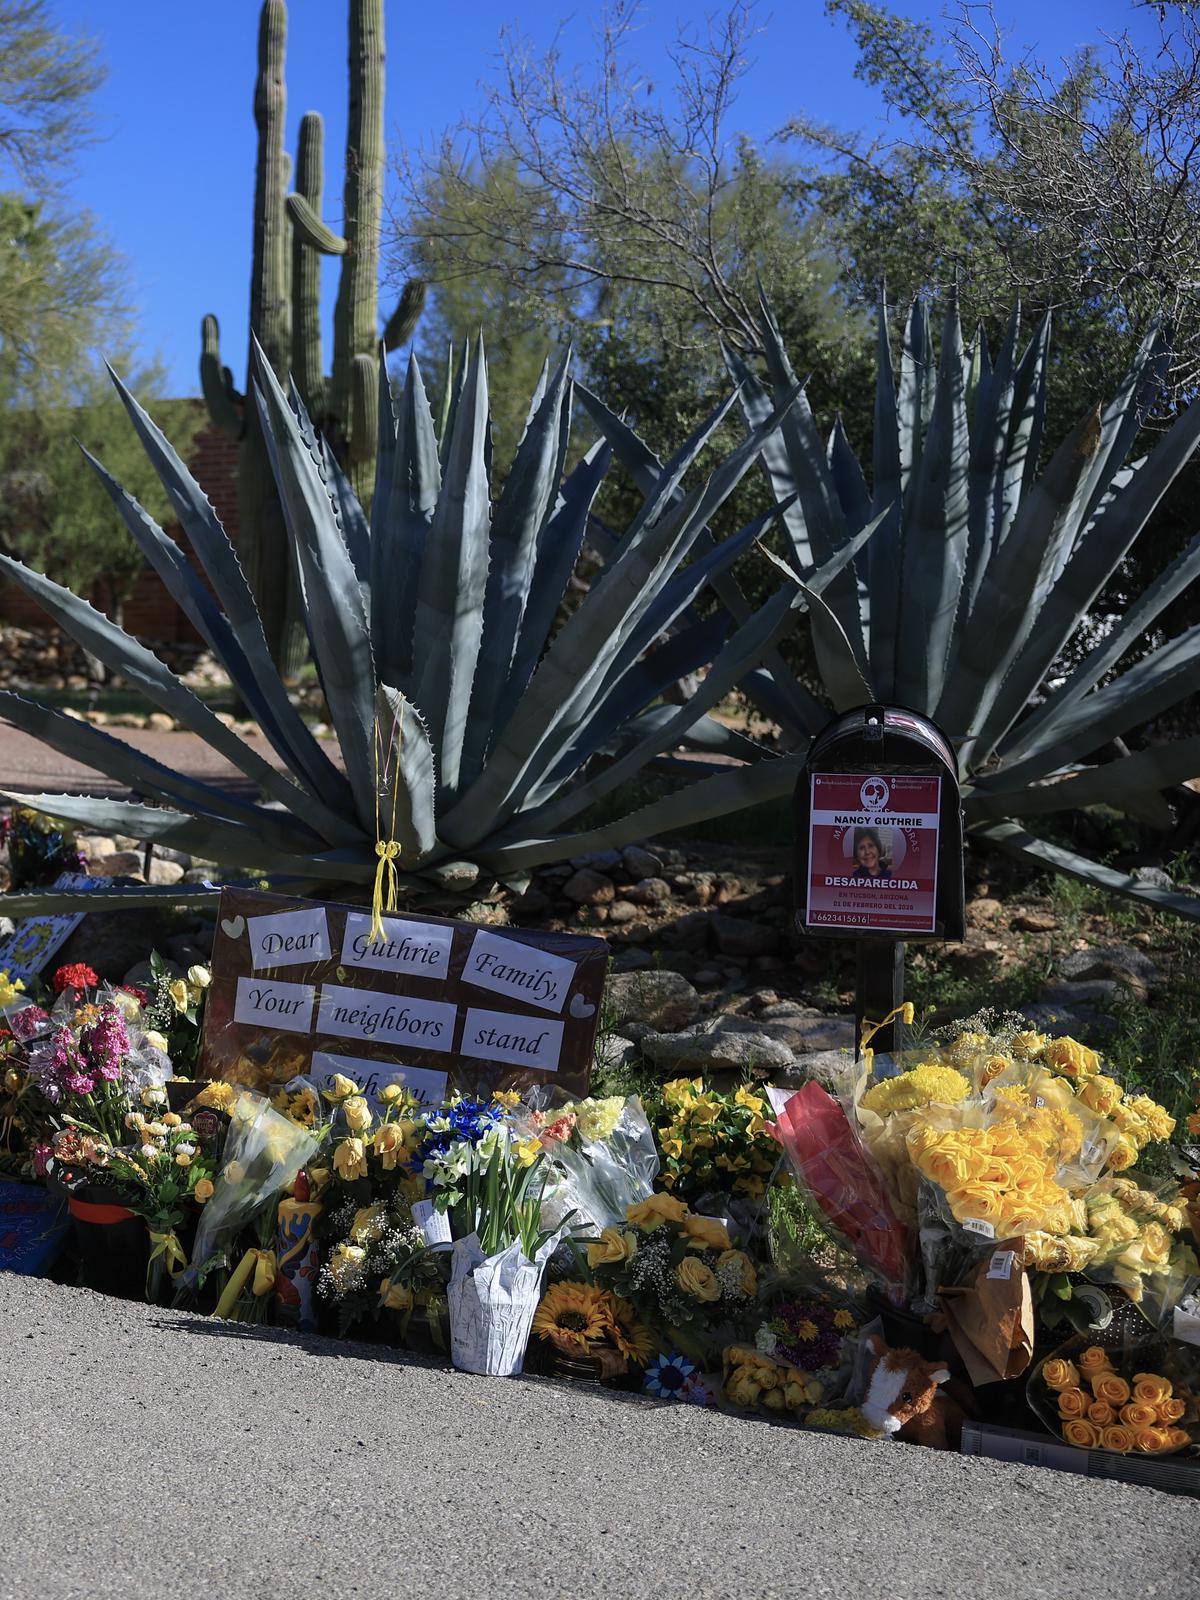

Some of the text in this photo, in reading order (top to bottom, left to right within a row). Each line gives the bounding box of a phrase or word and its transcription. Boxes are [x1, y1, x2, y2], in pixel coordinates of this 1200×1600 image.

[834, 815, 922, 826] NANCY GUTHRIE
[825, 876, 918, 889] DESAPARECIDA
[261, 931, 558, 1001] Dear Guthrie Family,
[249, 988, 550, 1055] Your neighbors stand
